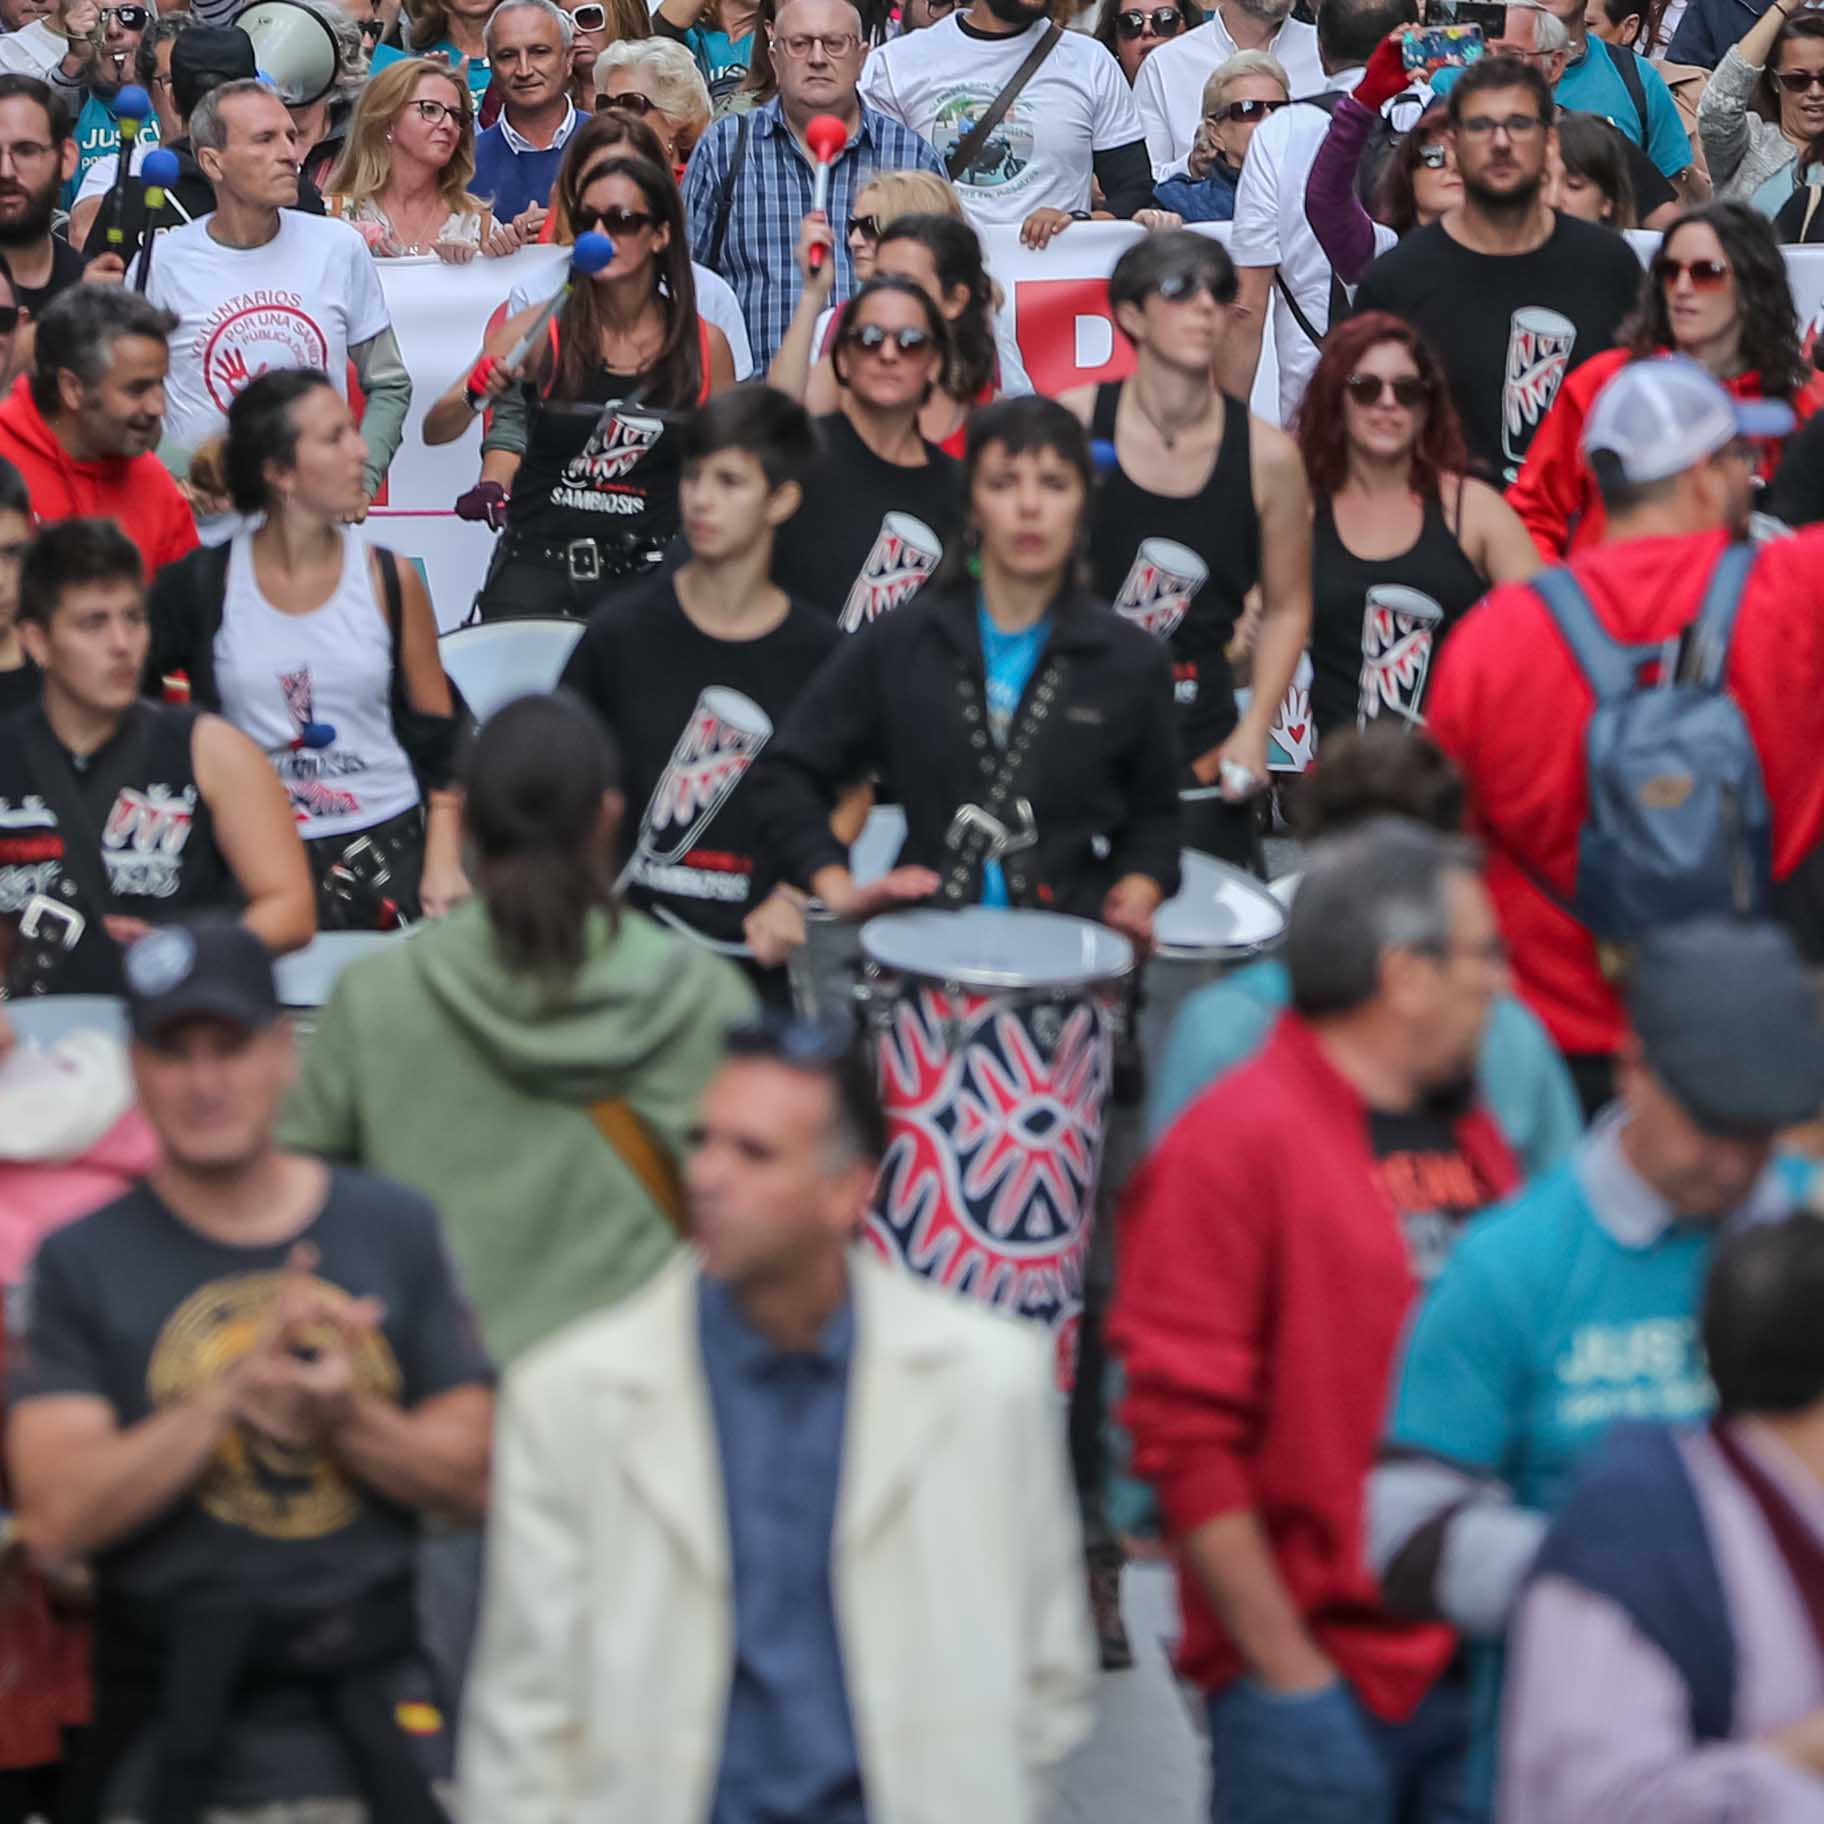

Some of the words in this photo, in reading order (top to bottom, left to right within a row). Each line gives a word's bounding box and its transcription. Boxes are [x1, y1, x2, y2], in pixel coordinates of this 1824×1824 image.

[191, 290, 302, 358] VOLUNTARIOS
[224, 316, 256, 343] POR
[257, 312, 290, 328] UNA
